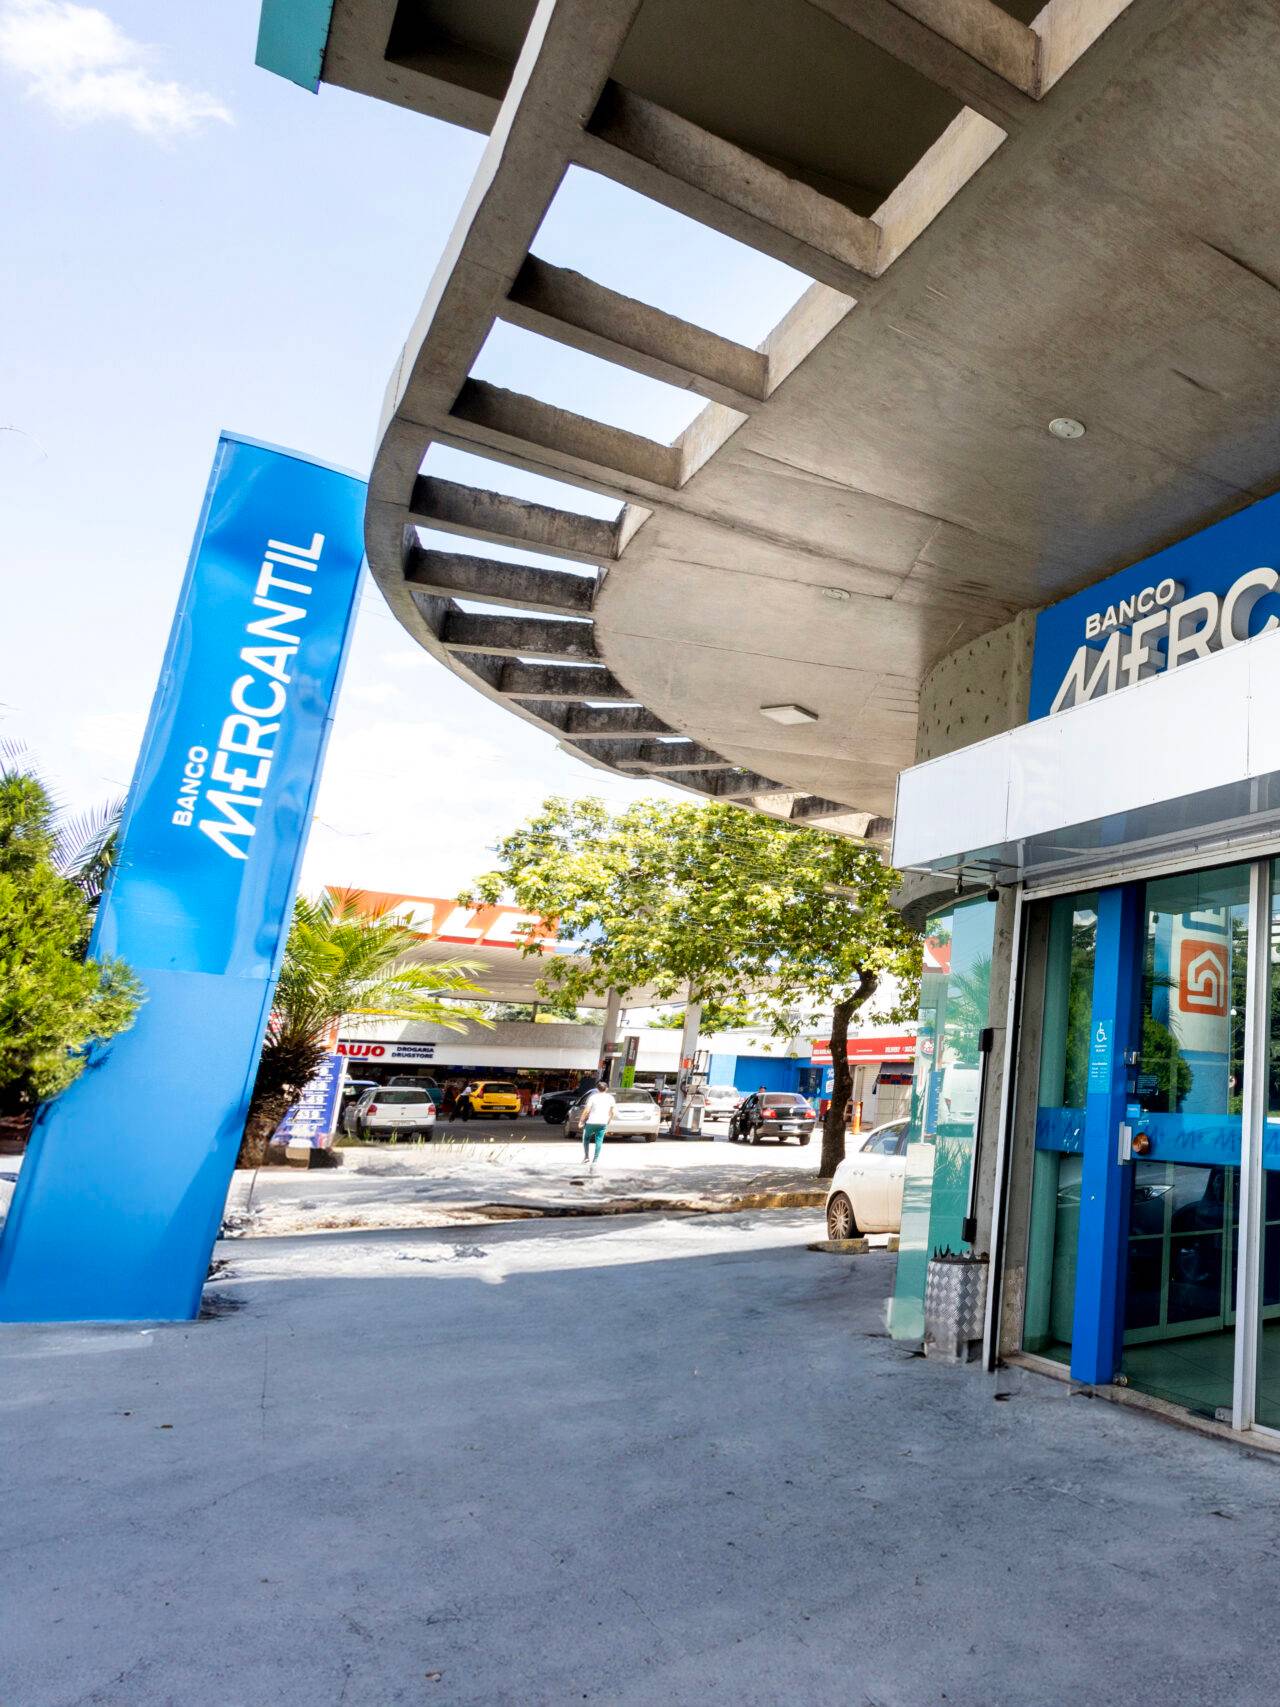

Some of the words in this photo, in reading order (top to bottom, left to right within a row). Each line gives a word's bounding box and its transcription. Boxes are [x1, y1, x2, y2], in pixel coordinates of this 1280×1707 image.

[1085, 578, 1182, 639] BANCO
[198, 532, 325, 860] MERCANTIL
[172, 745, 209, 827] BANCO
